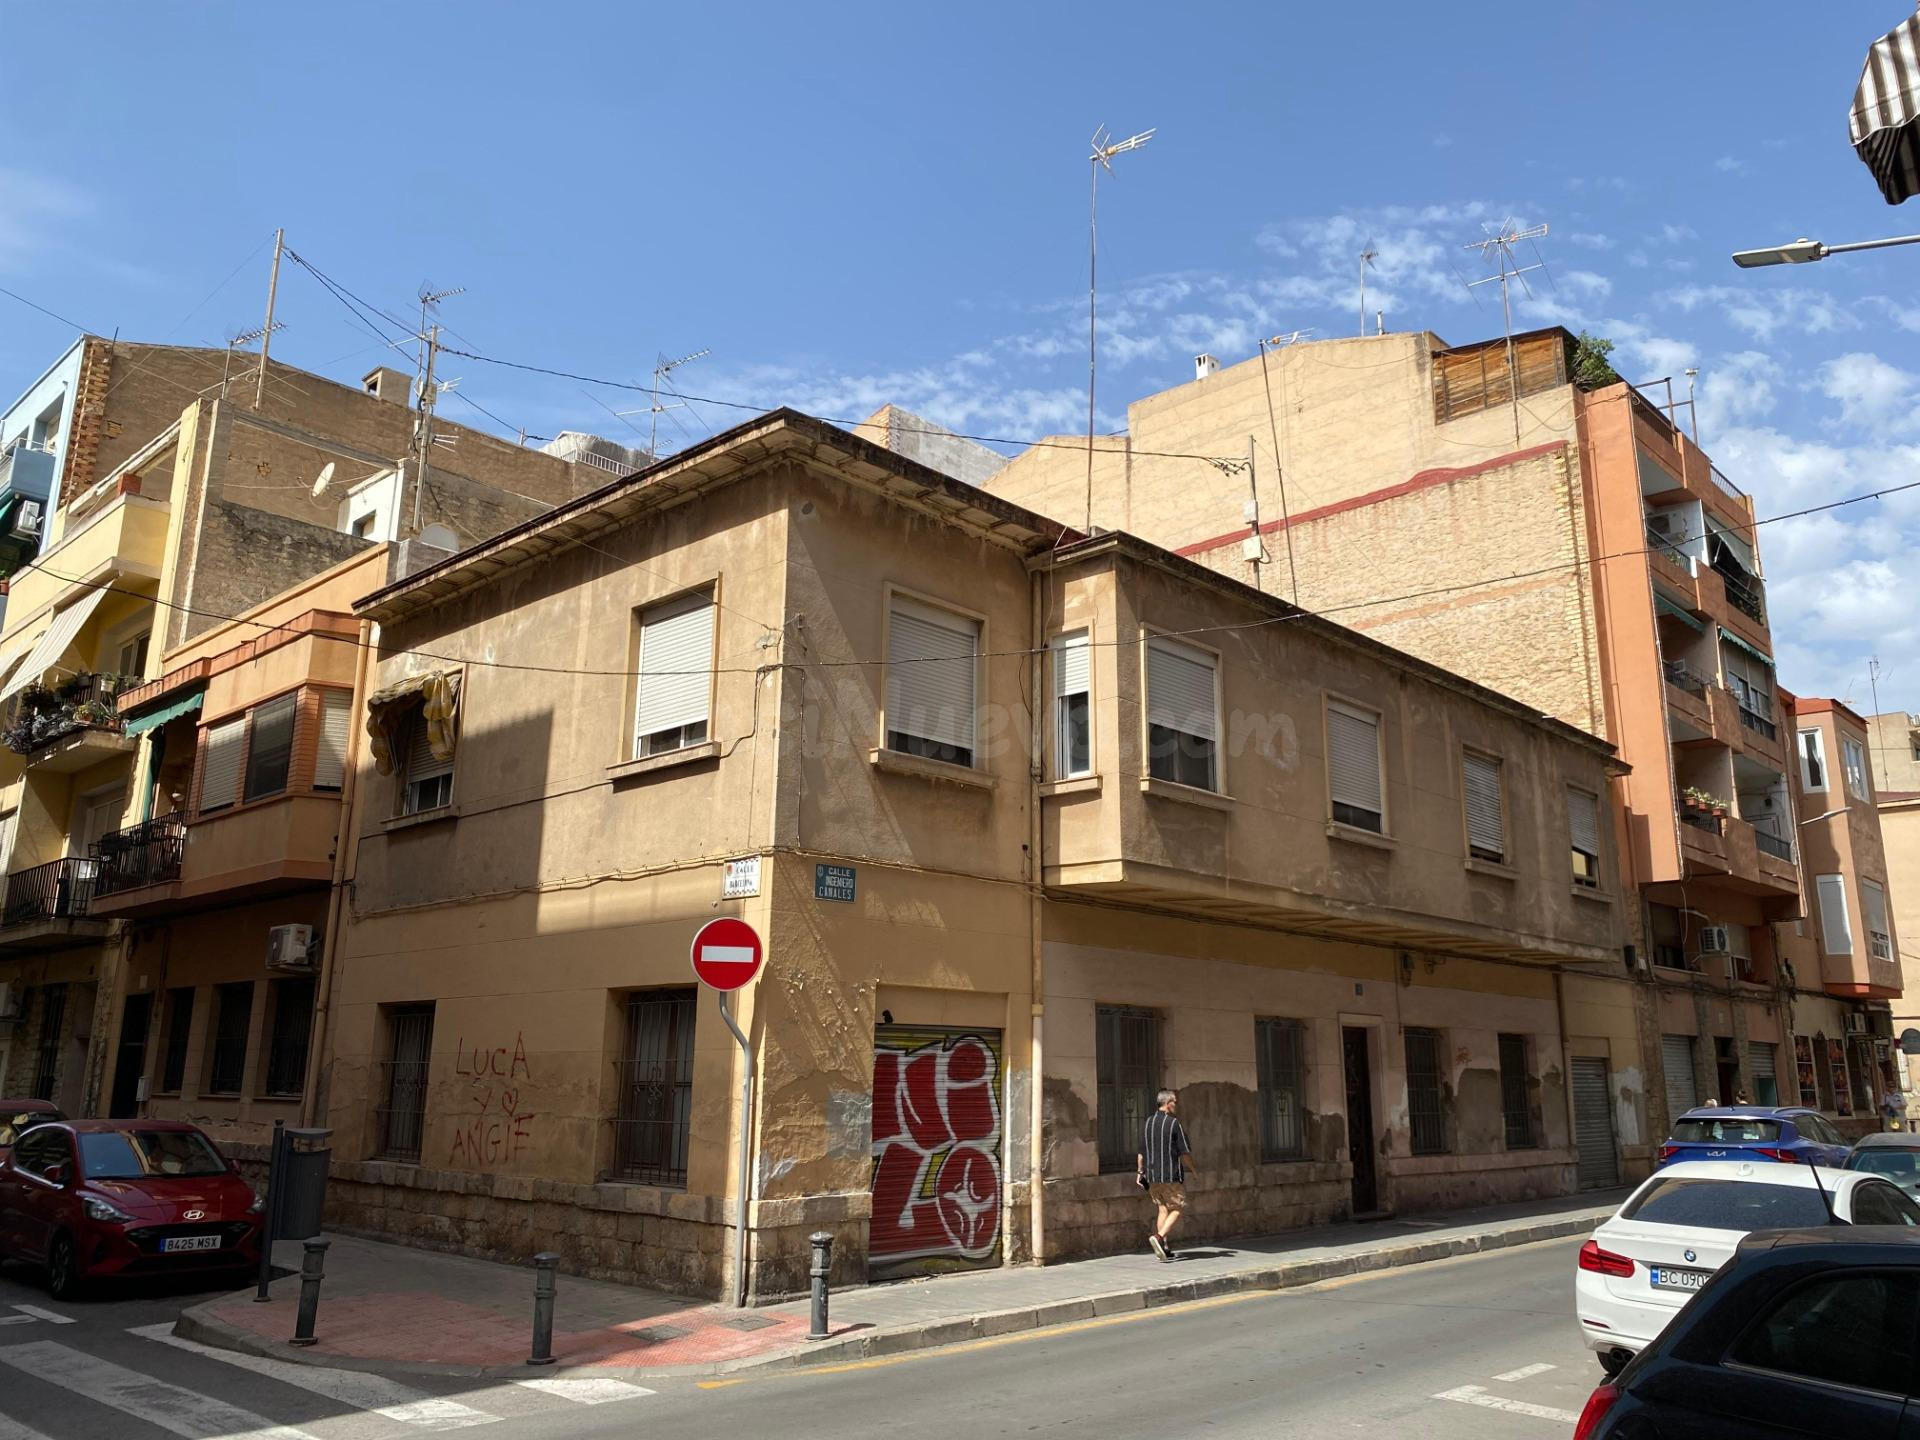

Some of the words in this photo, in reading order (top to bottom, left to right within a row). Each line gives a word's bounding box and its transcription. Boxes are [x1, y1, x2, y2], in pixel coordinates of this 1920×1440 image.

[735, 864, 754, 874] CALLE
[828, 867, 851, 877] CALLE
[825, 876, 853, 888] INGENIERO
[819, 886, 852, 900] CANALES
[456, 1031, 530, 1079] LUCA
[167, 1239, 194, 1250] 8425
[197, 1238, 219, 1248] MSX
[1660, 1270, 1678, 1284] BC
